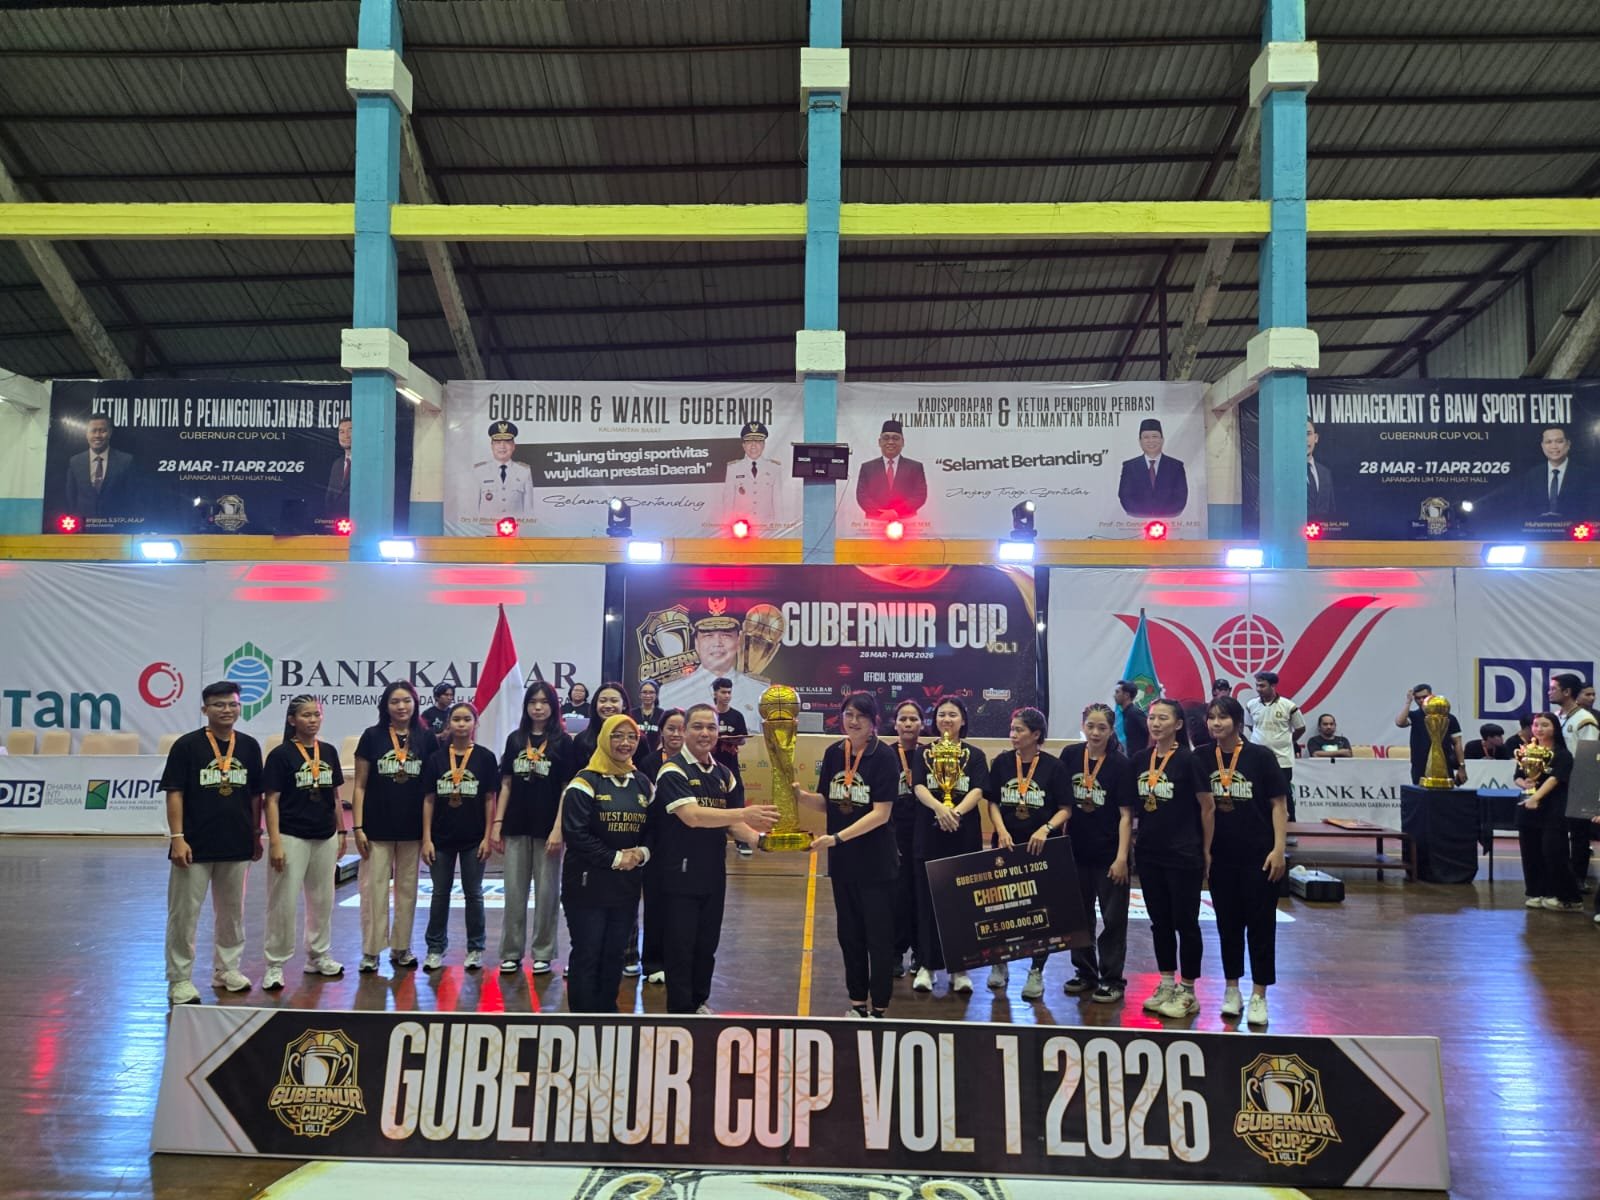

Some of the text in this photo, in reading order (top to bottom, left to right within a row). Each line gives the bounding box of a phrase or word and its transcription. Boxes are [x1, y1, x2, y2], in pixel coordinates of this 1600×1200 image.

[134, 398, 179, 428] PANITIA
[184, 399, 192, 427] &
[197, 398, 314, 429] PENANGGUNGJAWAB
[318, 399, 351, 429] KEGIA
[489, 393, 773, 426] GUBERNUR & WAKIL GUBERNUR
[918, 395, 1155, 427] KADISPORAPAR & KETUA PENGPROV PERBASI
[1331, 393, 1425, 424] MANAGEMENT
[1430, 393, 1439, 424] &
[1445, 394, 1479, 424] BAW
[1483, 394, 1525, 424] SPORT
[1531, 394, 1573, 424] EVENT
[892, 412, 993, 428] KALIMANTAN BARAT
[1017, 412, 1120, 428] KALIMANTAN BARAT
[180, 431, 286, 440] GUBERNUR CUP VOL 1
[1380, 431, 1489, 440] GUBERNUR CUP VOL 1
[606, 448, 643, 464] tinggi
[643, 446, 709, 462] sportivitas
[158, 460, 176, 473] 28
[178, 460, 211, 473] MAR
[222, 460, 234, 473] 11
[235, 460, 265, 473] APR
[267, 460, 304, 474] 2026
[544, 466, 609, 481] wujudkan
[610, 465, 660, 480] prestasi
[1359, 461, 1378, 474] 28
[1380, 461, 1415, 474] MAR
[1425, 461, 1437, 474] 11
[1438, 461, 1470, 474] APR
[1472, 461, 1511, 474] 2026
[543, 494, 705, 512] Selama Bertanding
[781, 602, 1008, 648] GUBERNUR CUP
[859, 651, 870, 659] 28
[870, 651, 888, 659] MAR
[898, 651, 914, 659] APR
[915, 651, 934, 660] 2026
[279, 659, 394, 688] BANK
[640, 651, 700, 681] GUBERN
[863, 671, 887, 682] OFFICIAL
[377, 759, 422, 775] CHAMIONS
[1299, 784, 1354, 799] BANK
[45, 798, 83, 806] BERSAMA
[600, 812, 620, 822] WEST
[956, 861, 1048, 887] GUBERNUR CUP VOL 1 2026
[973, 879, 1038, 906] CHAMPION
[270, 1086, 363, 1110] GUBERNUR
[379, 1020, 1210, 1163] GUBERNUR CUP VOL 1 2026
[300, 1104, 328, 1122] CUP
[1236, 1113, 1336, 1137] GUBERNUR
[1271, 1131, 1301, 1149] CUP
